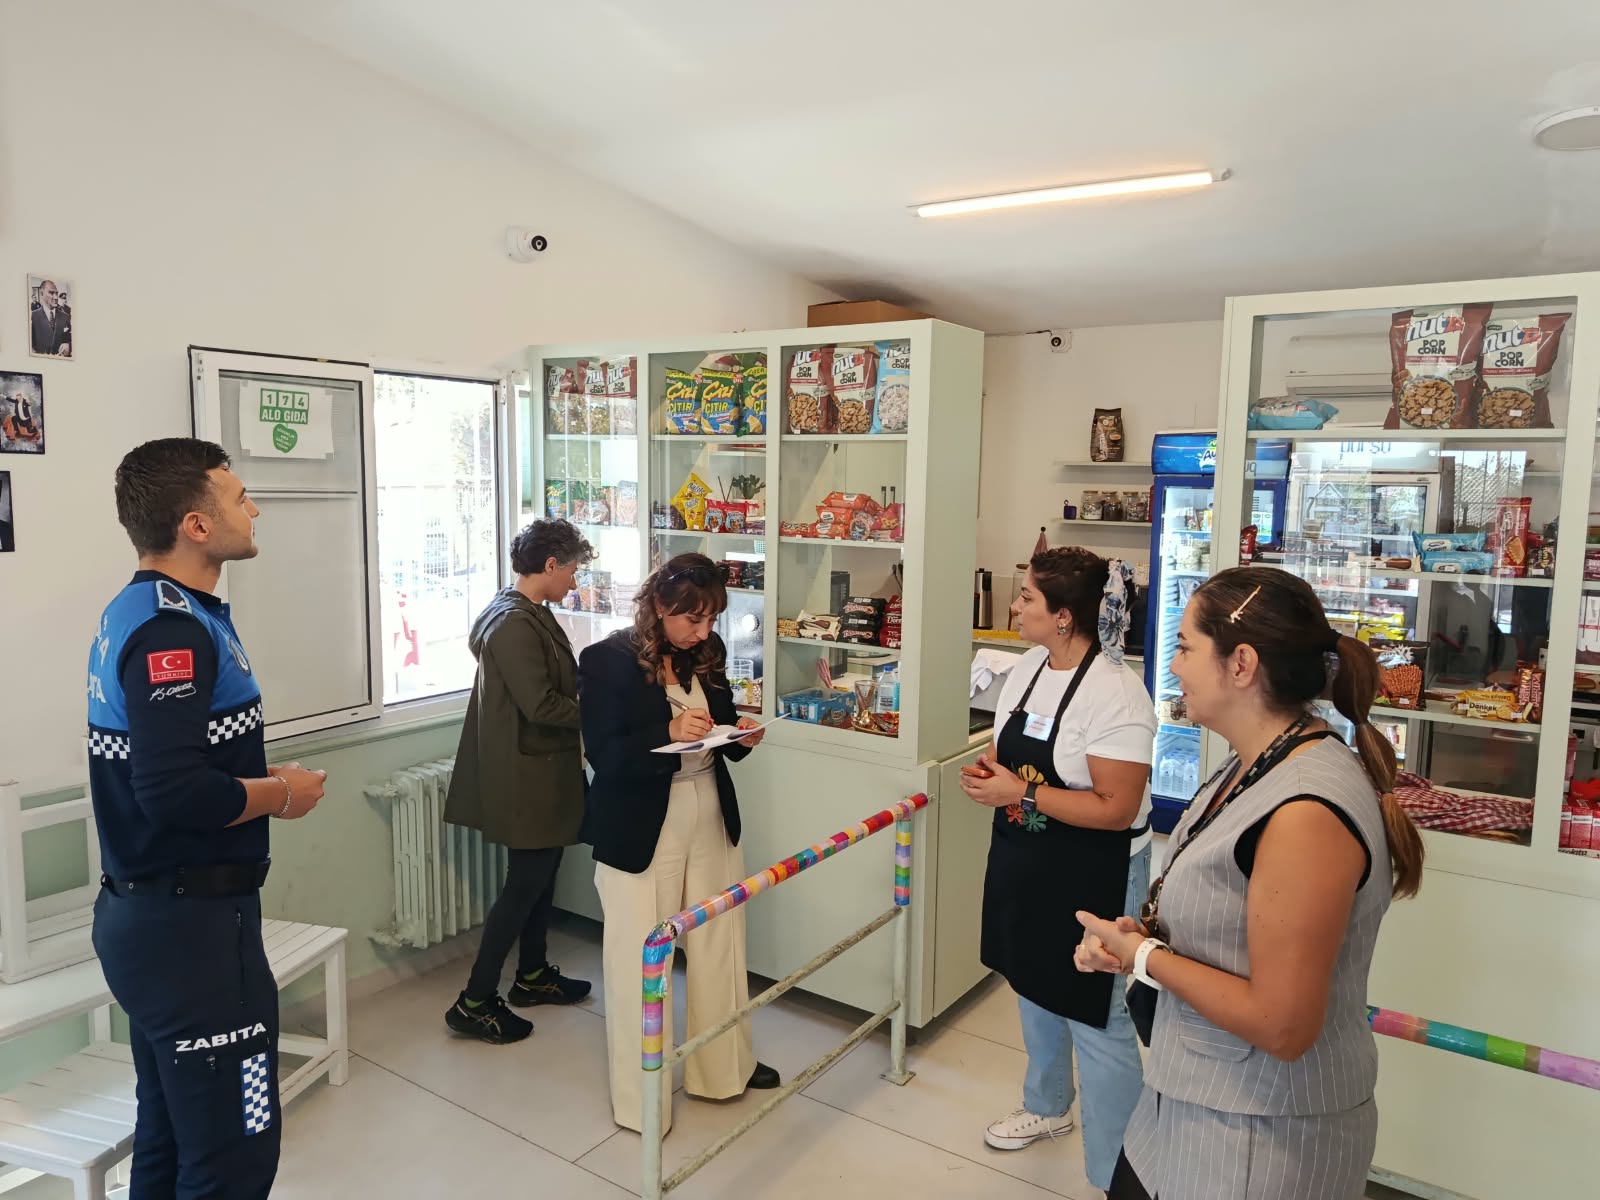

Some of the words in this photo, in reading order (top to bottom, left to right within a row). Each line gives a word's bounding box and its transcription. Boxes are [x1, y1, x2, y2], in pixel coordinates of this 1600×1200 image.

[1423, 340, 1445, 348] POP
[1418, 347, 1446, 355] CORN
[1500, 352, 1523, 360] POP
[1495, 359, 1524, 367] CORN
[840, 376, 857, 384] CORN
[261, 409, 281, 420] ALO
[284, 410, 307, 423] GIDA
[175, 1022, 267, 1052] ZABITA
